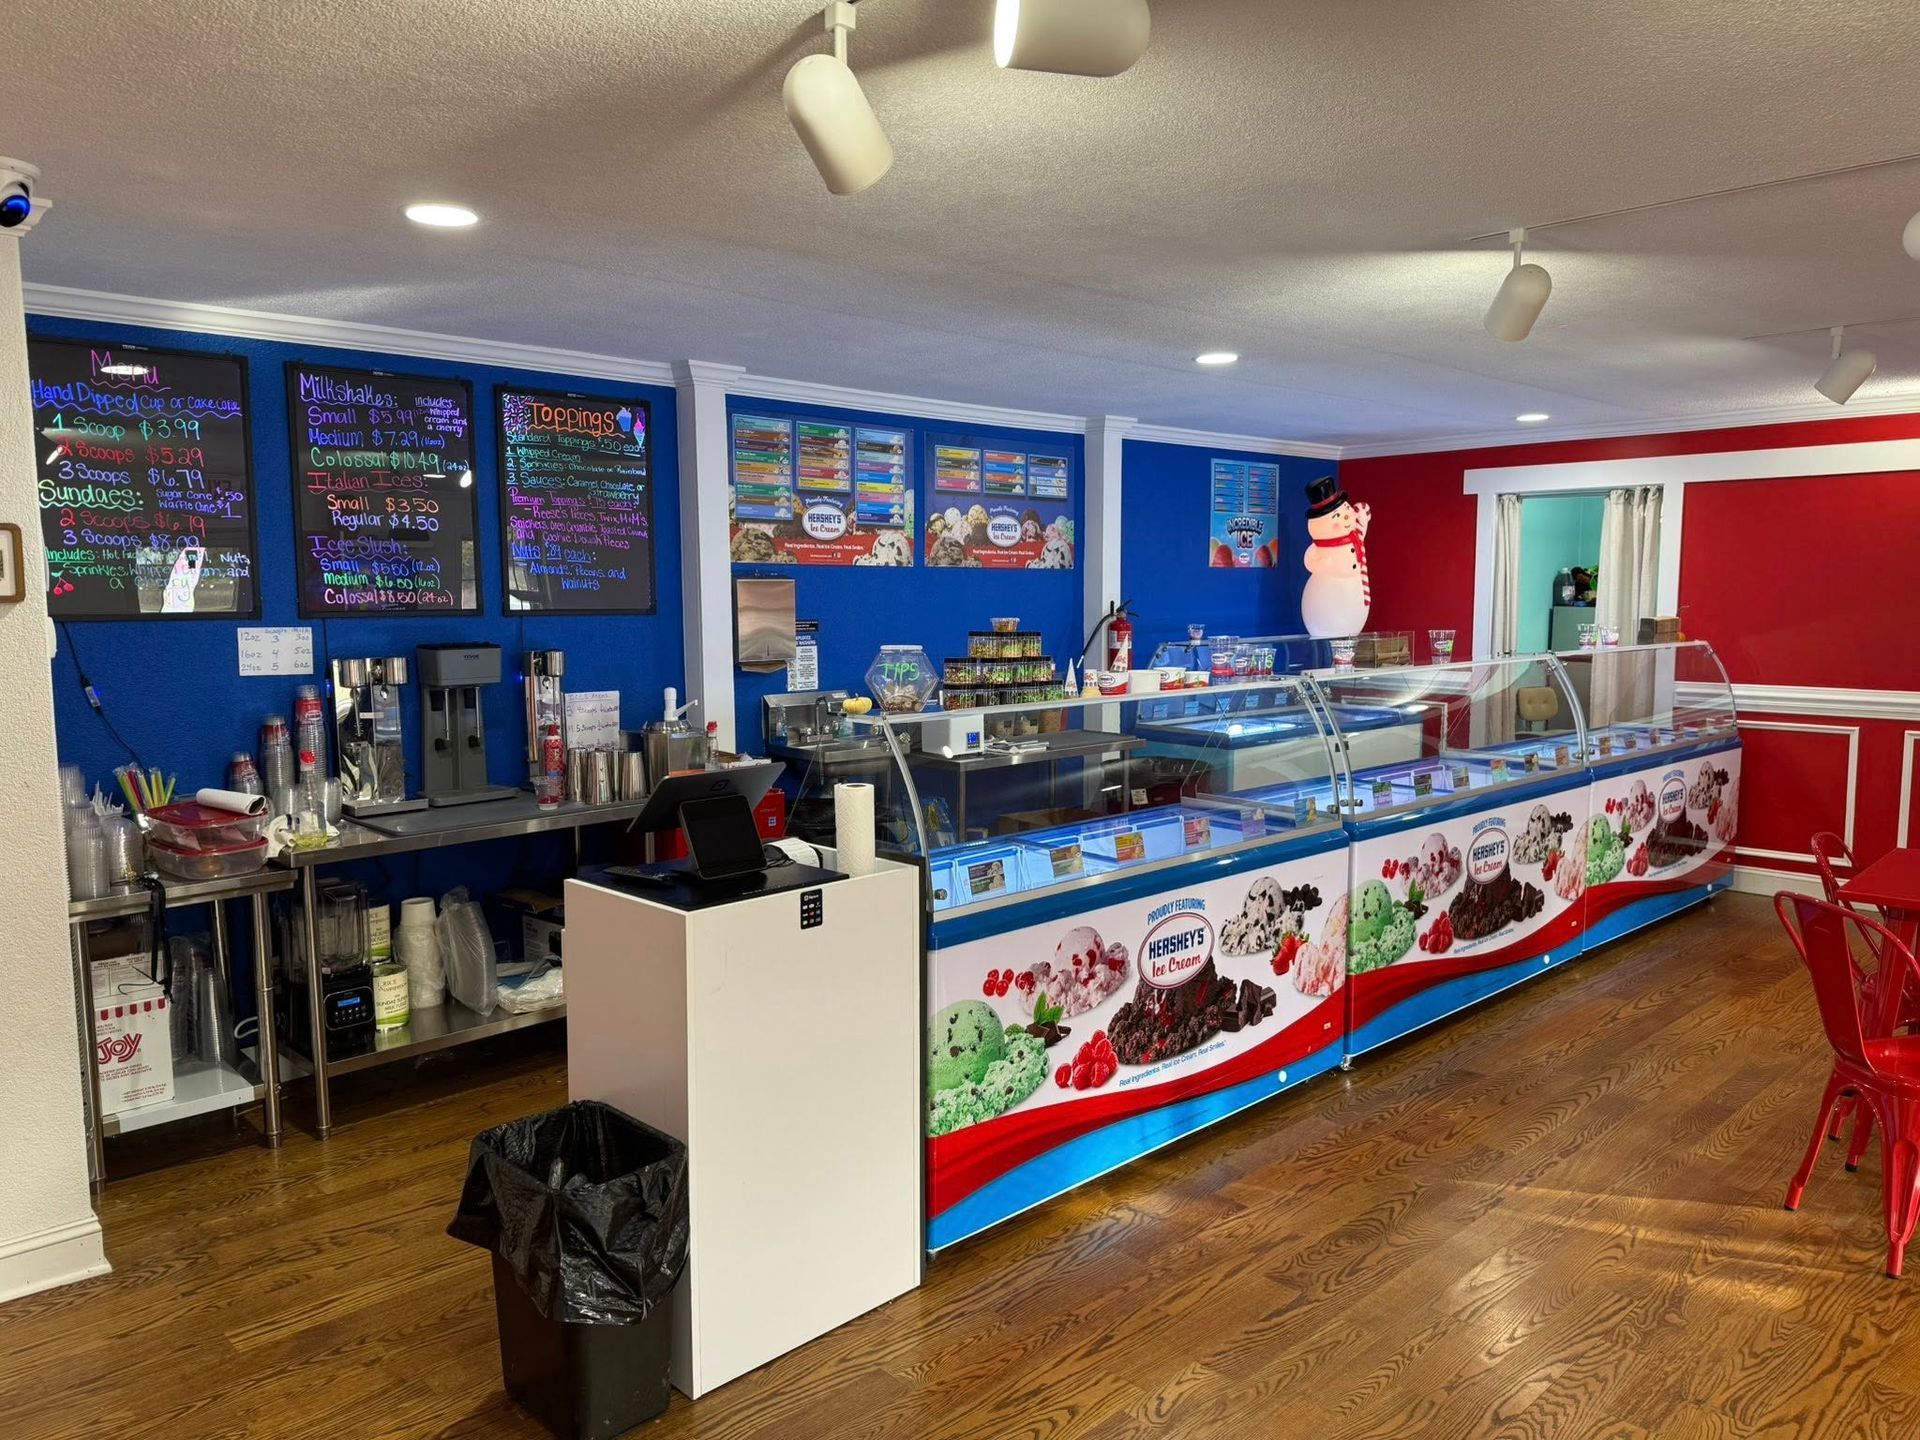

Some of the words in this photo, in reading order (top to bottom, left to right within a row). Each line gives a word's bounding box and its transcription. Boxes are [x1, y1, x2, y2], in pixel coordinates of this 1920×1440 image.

[141, 395, 164, 411] Cup
[307, 406, 357, 426] Small
[525, 402, 614, 438] Toppings
[53, 413, 66, 432] 1
[74, 416, 125, 441] Scoop
[139, 419, 200, 441] $3.99
[308, 428, 363, 448] Medium
[372, 430, 420, 448] $7.29
[75, 440, 135, 464] Scoops
[146, 446, 204, 468] $5.29
[310, 446, 385, 468] Colossal
[59, 461, 73, 480] 3
[75, 461, 131, 485] Scoops
[147, 466, 205, 489] $6.79
[307, 471, 369, 489] Italian
[38, 480, 144, 505] Sundaes:
[327, 494, 369, 511] Small
[385, 496, 439, 514] $3.50
[60, 508, 75, 527] 2
[79, 511, 150, 532] Scoops
[332, 510, 383, 532] Regular
[388, 514, 439, 531] $4.50
[808, 513, 842, 523] HERSHEY'S
[991, 523, 1018, 533] HERSHEY'S
[63, 530, 78, 546] 3
[81, 530, 142, 549] Scoops
[1237, 530, 1254, 548] ICE
[320, 558, 360, 572] Small
[272, 635, 279, 643] 3
[272, 662, 279, 671] 5
[876, 661, 920, 681] TIPS
[1472, 840, 1505, 860] HERSHEY'S
[1474, 863, 1482, 875] Ice
[1483, 859, 1502, 873] Cream
[1147, 901, 1176, 926] PROUDLY
[1175, 898, 1206, 913] FEATURING
[1148, 927, 1205, 960] HERSHEY'S
[1152, 962, 1167, 978] Ice
[1168, 953, 1202, 975] Cream
[1118, 1078, 1131, 1088] Real
[1161, 1061, 1173, 1070] Real
[1197, 1047, 1209, 1057] Real
